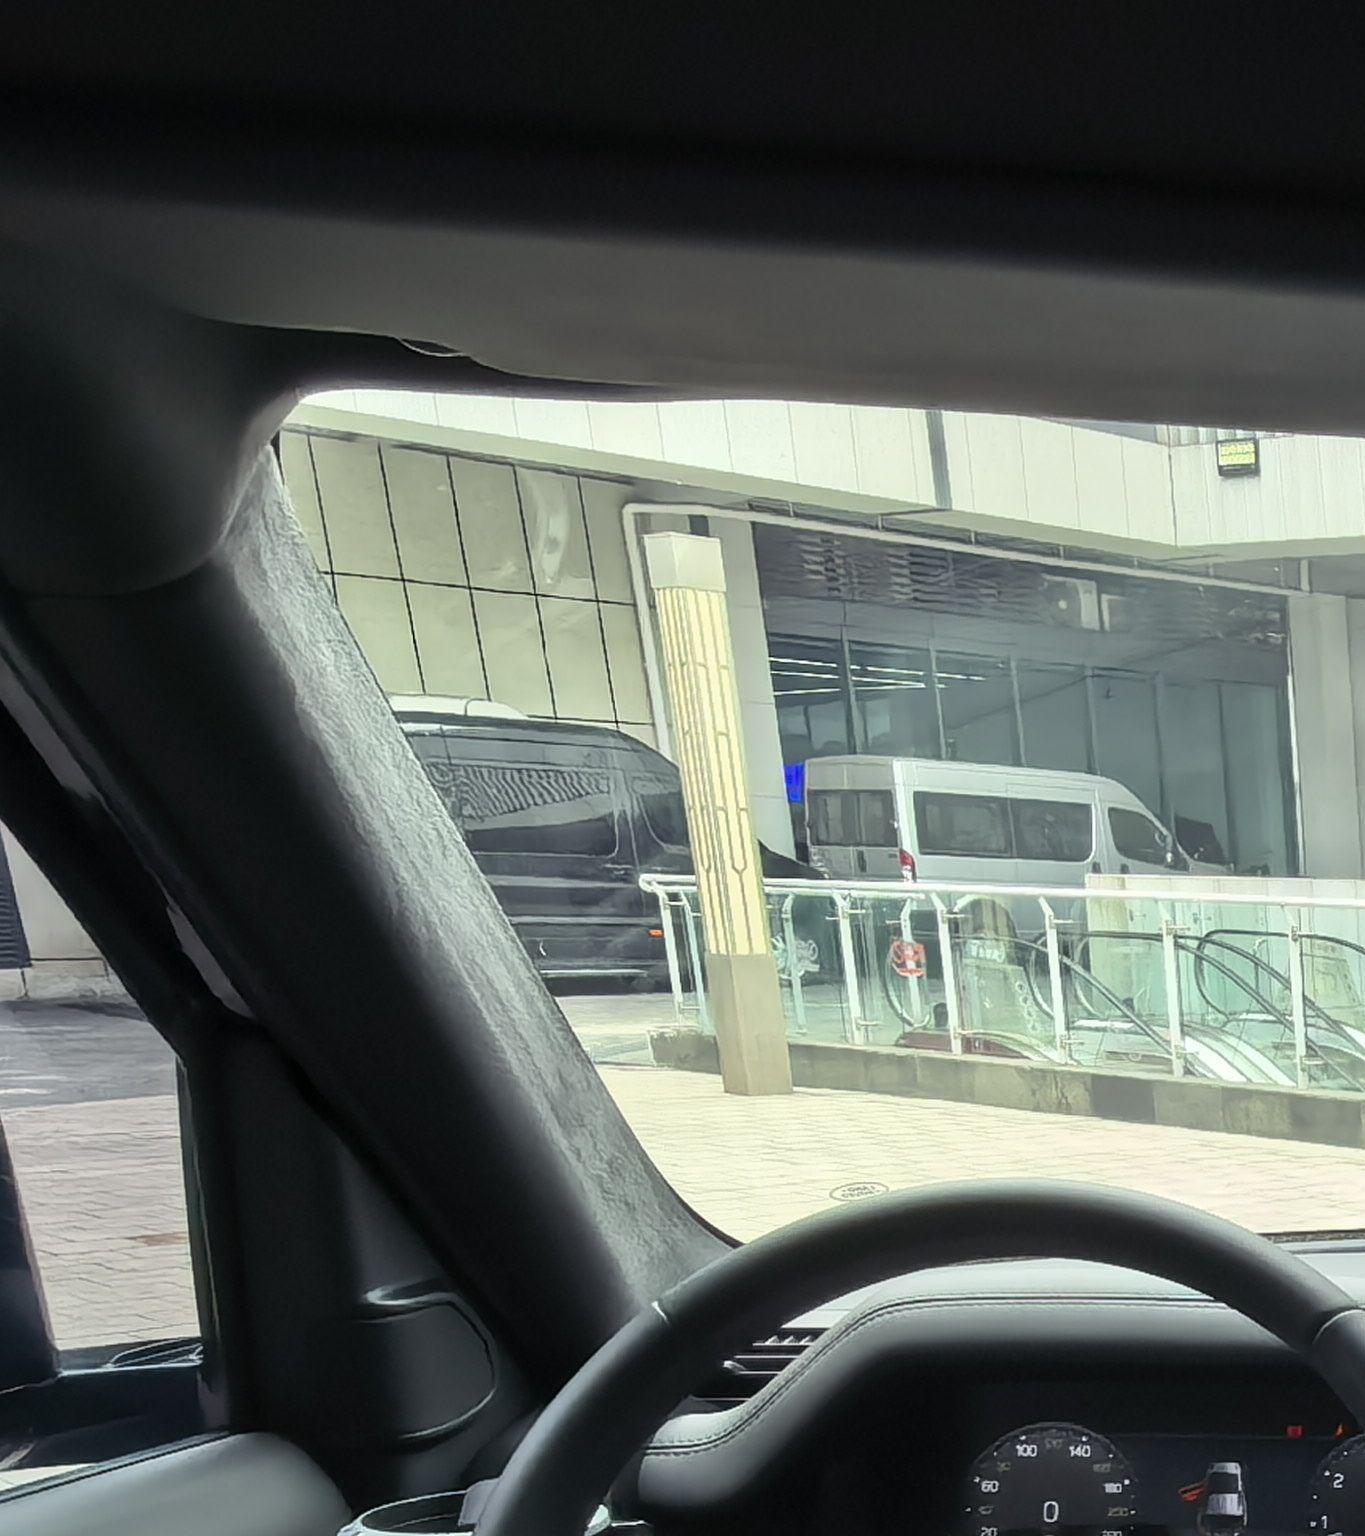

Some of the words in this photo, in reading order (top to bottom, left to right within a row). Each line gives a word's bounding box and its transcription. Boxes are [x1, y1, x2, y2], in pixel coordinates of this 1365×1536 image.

[1016, 1444, 1037, 1457] 100
[1069, 1444, 1091, 1457] 140
[981, 1480, 999, 1493] 60
[1333, 1473, 1344, 1488] 2
[1043, 1501, 1059, 1523] 0
[1321, 1515, 1328, 1529] 1
